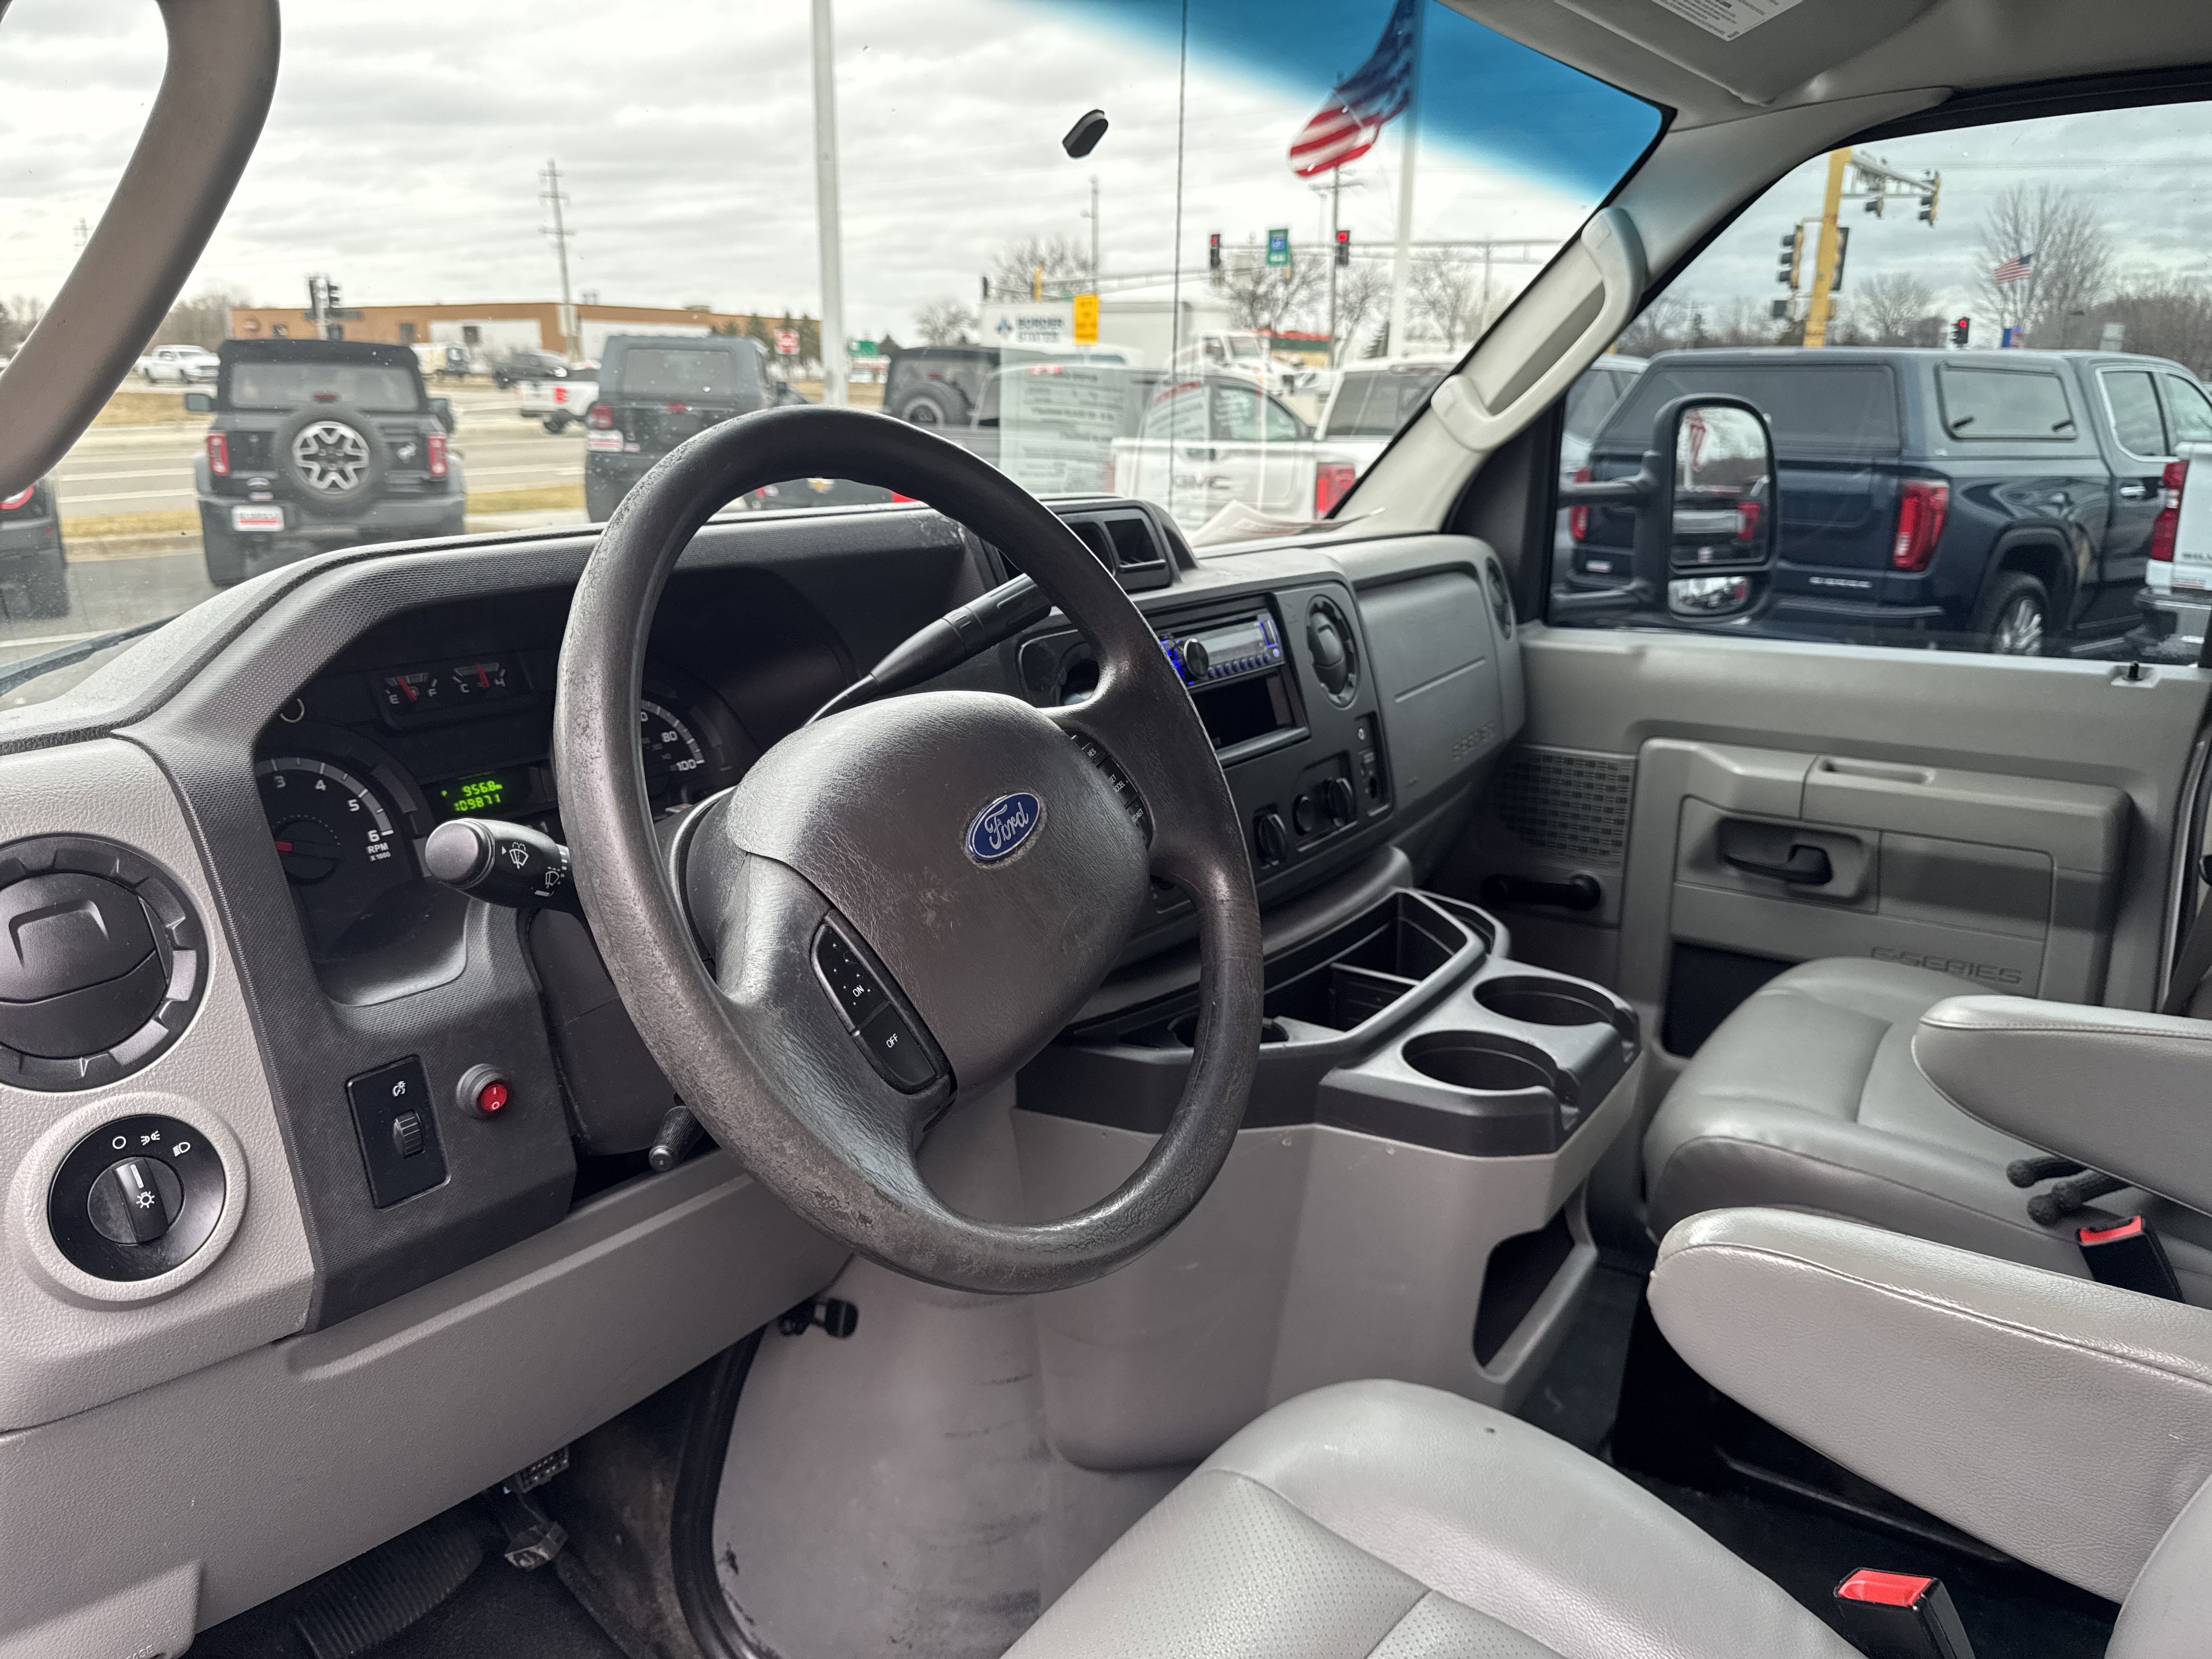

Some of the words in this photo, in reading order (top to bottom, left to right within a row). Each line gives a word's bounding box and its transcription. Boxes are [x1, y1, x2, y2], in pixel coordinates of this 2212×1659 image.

[428, 688, 437, 697] F
[461, 684, 470, 693] C
[390, 694, 400, 704] E
[641, 712, 648, 722] 0
[661, 731, 678, 742] 80
[1087, 748, 1097, 758] RES
[675, 759, 697, 771] 100
[275, 776, 286, 788] 3
[1108, 774, 1117, 784] SET
[315, 780, 326, 791] 4
[348, 799, 360, 812] 5
[453, 794, 501, 811] 109871
[1131, 808, 1144, 823] COAST
[984, 802, 1029, 849] Ford
[368, 830, 380, 843] 6
[366, 842, 390, 855] RPM
[853, 985, 864, 997] ON
[886, 1033, 898, 1048] OFF
